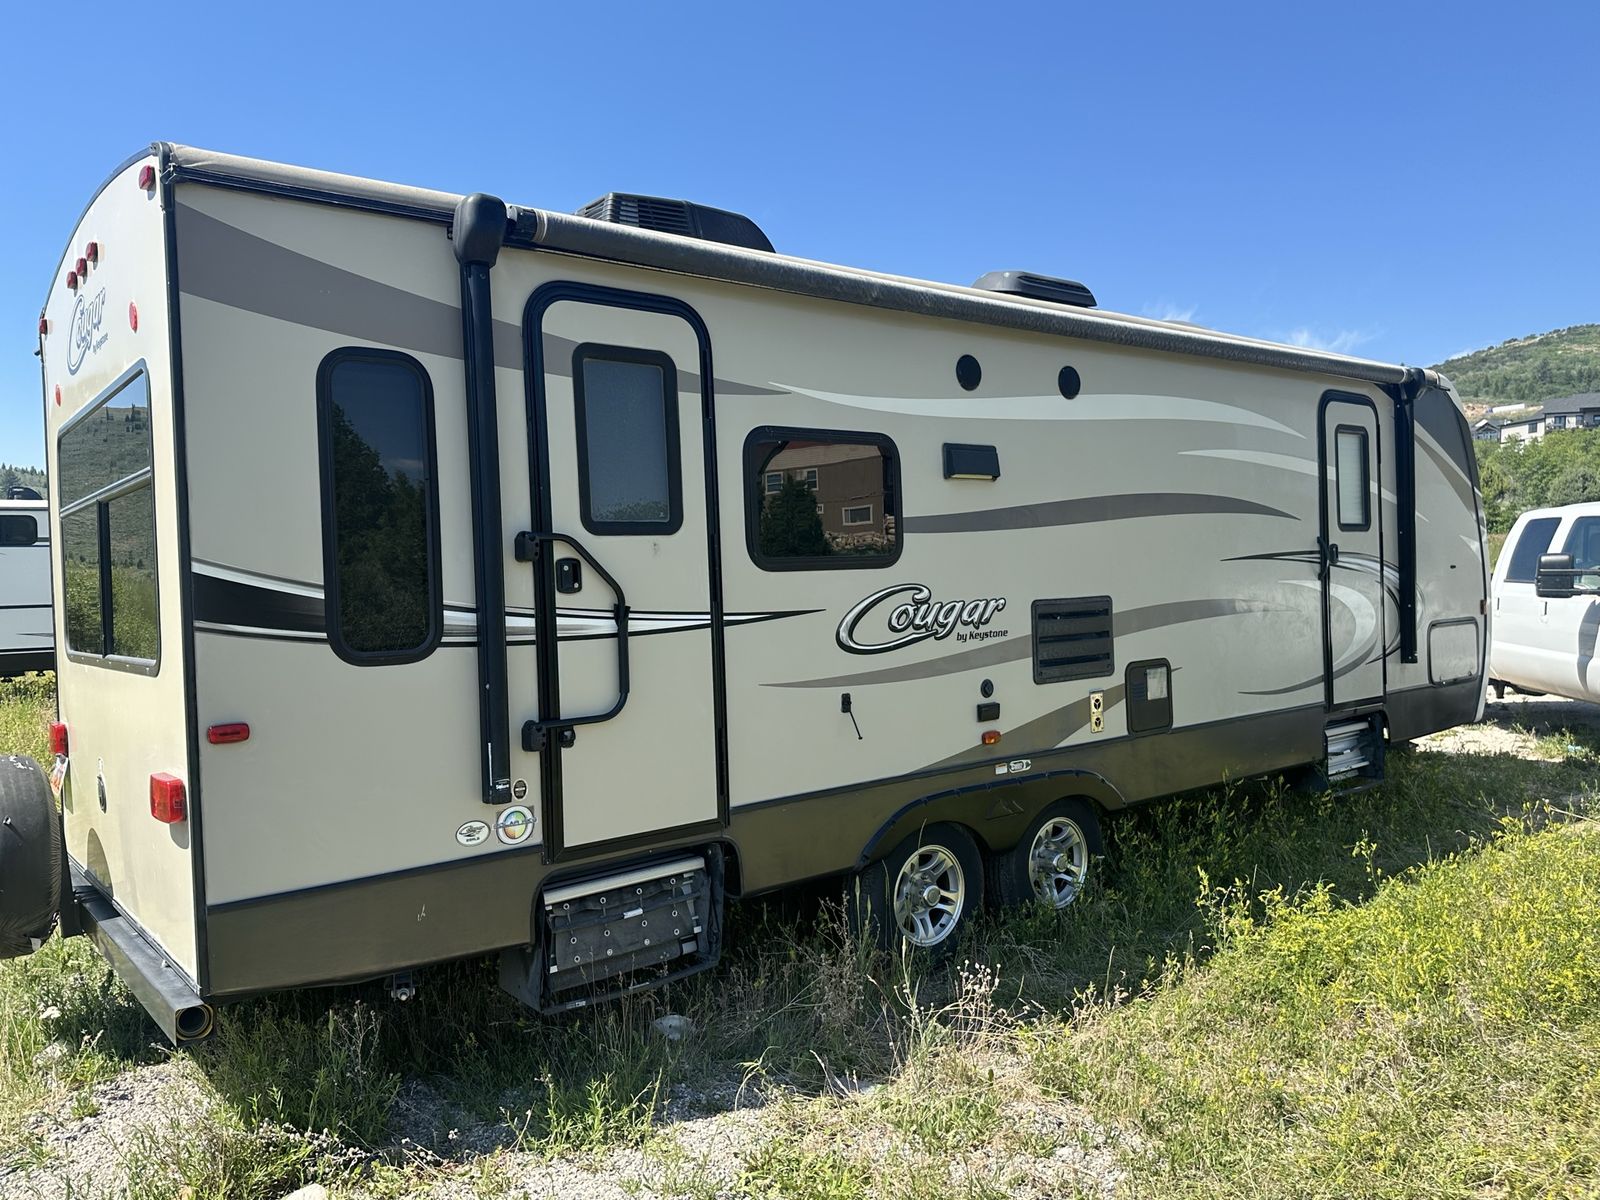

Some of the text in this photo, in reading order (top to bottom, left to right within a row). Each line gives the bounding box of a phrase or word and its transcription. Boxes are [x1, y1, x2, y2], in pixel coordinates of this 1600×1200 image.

[67, 287, 106, 376] Cougar
[836, 583, 1006, 655] Cougar
[956, 629, 1009, 643] by Keystone
